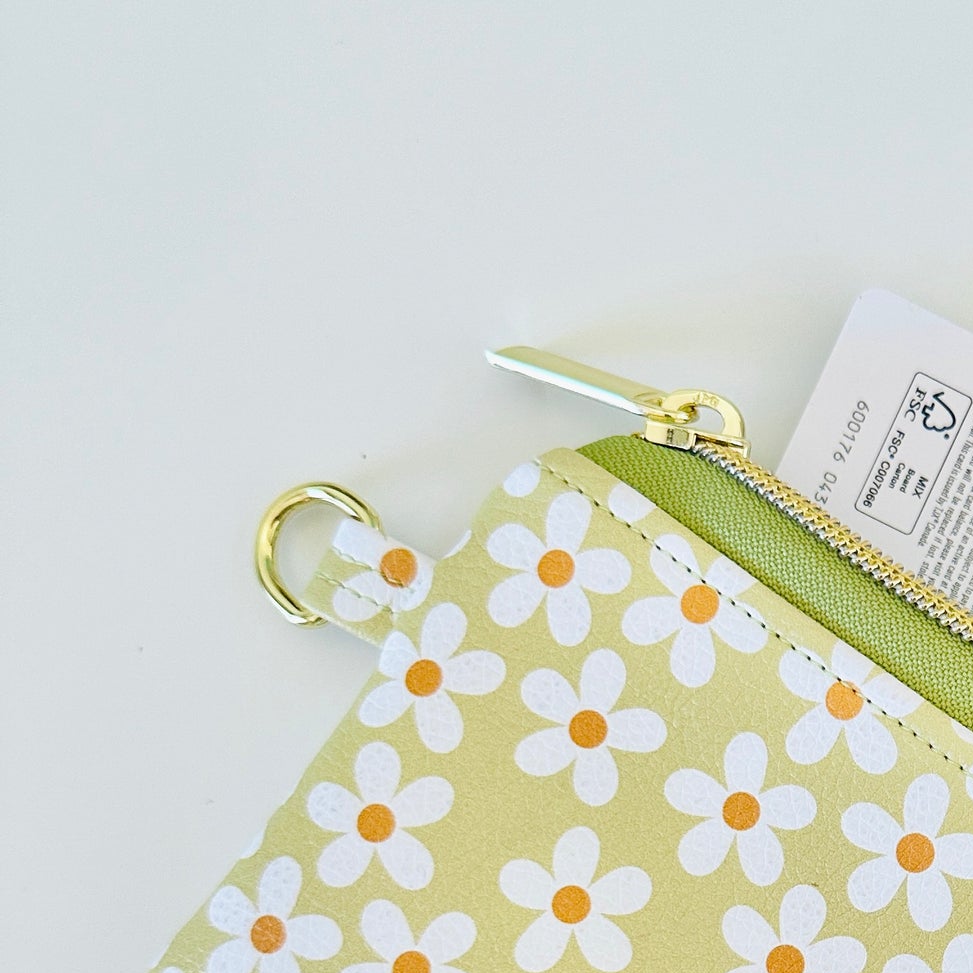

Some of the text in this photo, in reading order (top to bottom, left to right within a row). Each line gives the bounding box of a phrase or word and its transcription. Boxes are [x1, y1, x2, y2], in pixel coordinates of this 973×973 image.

[904, 387, 927, 422] FSC
[833, 400, 870, 462] 600176
[863, 460, 891, 508] C007066
[888, 462, 906, 489] Carton
[899, 468, 916, 494] Board
[912, 476, 929, 499] MIX
